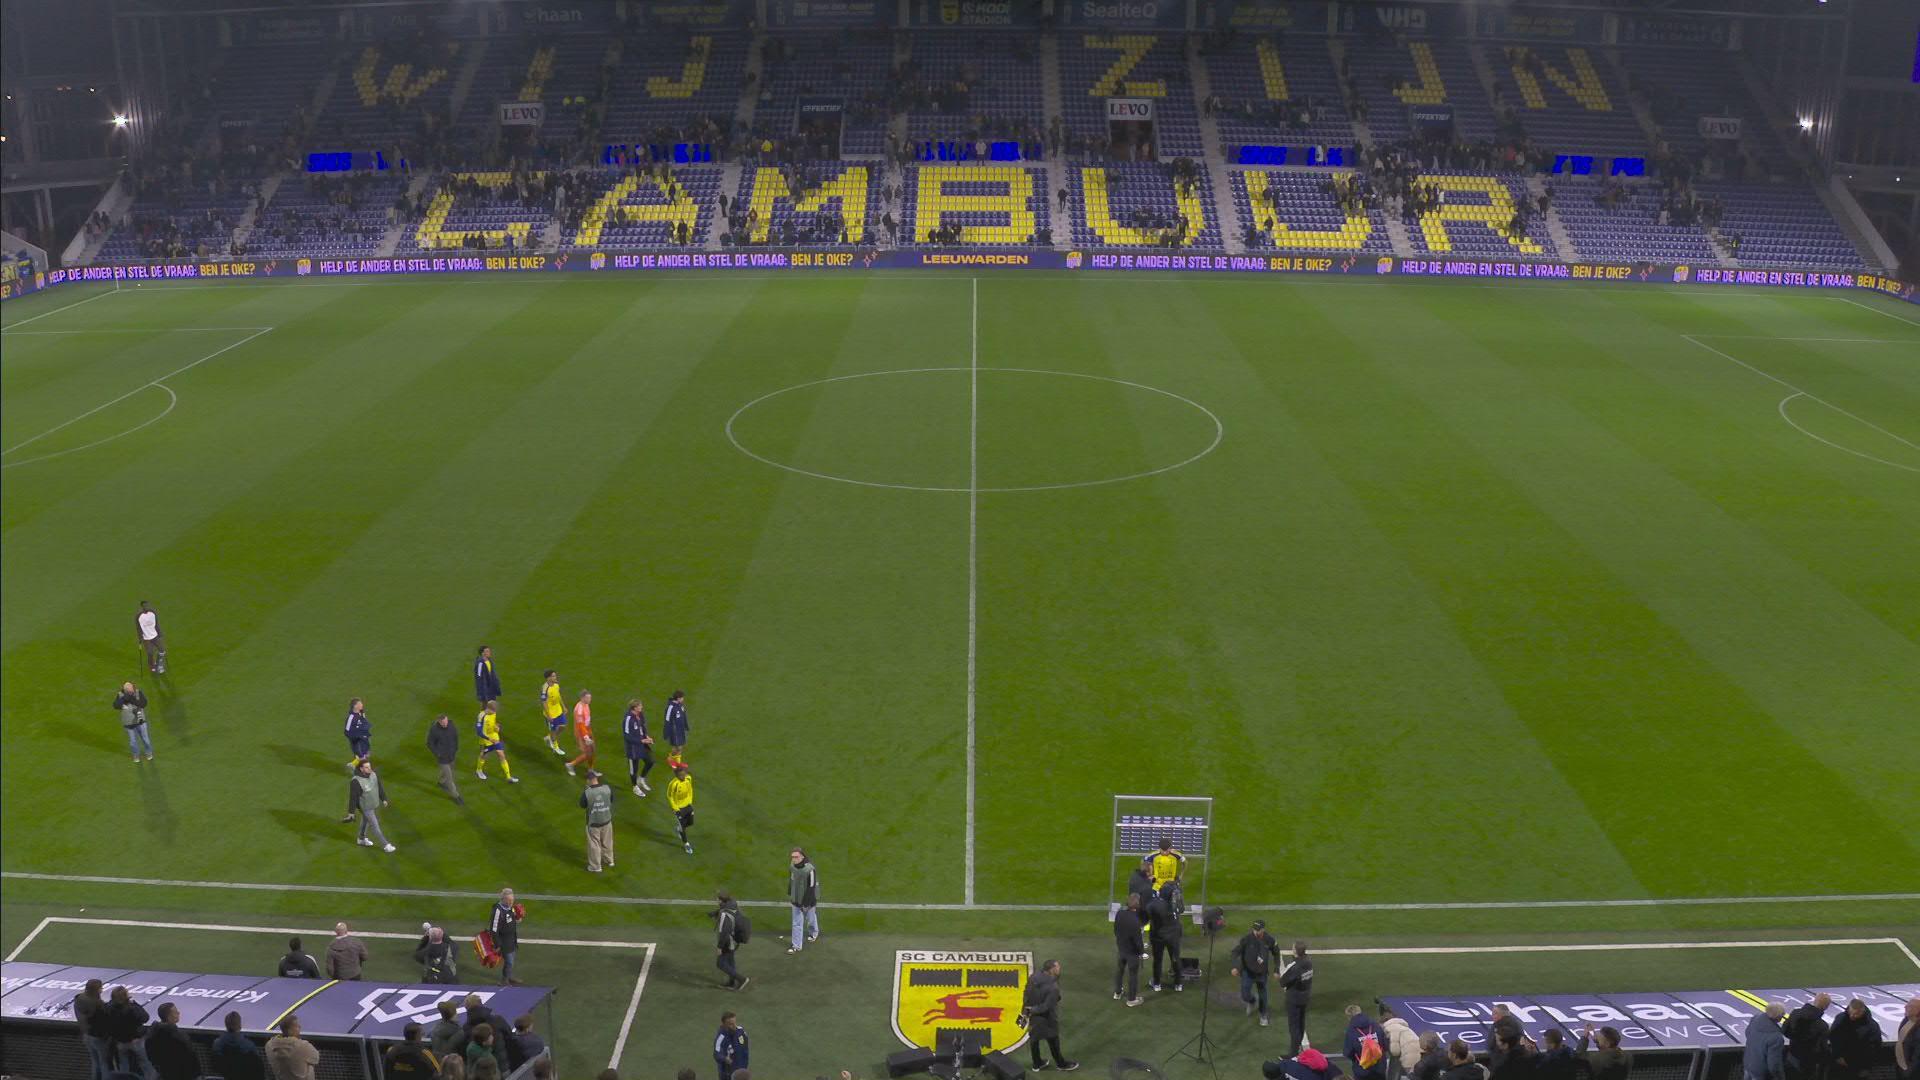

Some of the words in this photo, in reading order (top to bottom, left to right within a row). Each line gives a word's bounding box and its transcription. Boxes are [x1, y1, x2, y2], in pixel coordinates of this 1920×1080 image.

[1110, 103, 1149, 116] LEVO
[1702, 121, 1737, 134] LEVO
[320, 261, 344, 273] HELP
[346, 260, 358, 273] DE
[360, 260, 392, 272] ANDER
[393, 259, 406, 272] EN
[408, 259, 431, 271] STEL
[433, 258, 446, 270] DE
[447, 258, 483, 270] VRAAG:
[486, 257, 506, 270] BEN
[508, 257, 518, 269] JE
[520, 257, 546, 269] OKE?
[615, 255, 640, 268] HELP
[642, 255, 655, 267] DE
[657, 254, 691, 267] ANDER
[693, 254, 706, 267] EN
[708, 254, 733, 267] STEL
[735, 253, 748, 266] DE
[750, 253, 788, 266] VRAAG:
[791, 253, 811, 266] BEN
[814, 253, 824, 266] JE
[826, 253, 854, 266] OKE?
[922, 254, 1029, 265] LEEUWARDEN
[1092, 255, 1118, 267] HELP
[1120, 255, 1133, 268] DE
[1135, 255, 1170, 268] ANDER
[1172, 255, 1186, 268] EN
[1187, 256, 1212, 269] STEL
[1214, 256, 1228, 269] DE
[1230, 256, 1267, 270] VRAAG:
[1270, 257, 1290, 270] BEN
[1292, 258, 1303, 271] JE
[1305, 258, 1332, 271] OKE?
[69, 268, 81, 281] DE
[84, 267, 112, 280] ANDER
[115, 266, 126, 279] EN
[128, 266, 148, 278] STEL
[151, 265, 163, 277] DE
[164, 265, 198, 277] VRAAG:
[200, 264, 218, 276] BEN
[220, 263, 230, 276] JE
[231, 263, 256, 275] OKE?
[1401, 260, 1427, 273] HELP
[1429, 261, 1442, 274] DE
[1443, 261, 1477, 274] ANDER
[1480, 262, 1492, 275] EN
[1494, 262, 1517, 276] STEL
[1519, 263, 1532, 276] DE
[1534, 264, 1570, 277] VRAAG:
[1572, 265, 1592, 278] BEN
[1593, 265, 1604, 278] JE
[1605, 266, 1632, 279] OKE?
[1696, 269, 1720, 282] HELP
[1722, 270, 1735, 283] DE
[1736, 270, 1767, 283] ANDER
[1769, 271, 1782, 284] EN
[1783, 272, 1805, 285] STEL
[1807, 272, 1819, 286] DE
[1821, 273, 1854, 287] VRAAG:
[1857, 274, 1876, 288] BEN
[1877, 277, 1885, 290] JE
[901, 952, 926, 961] SC
[932, 952, 1028, 963] CAMBUUR
[1492, 1001, 1753, 1023] haan
